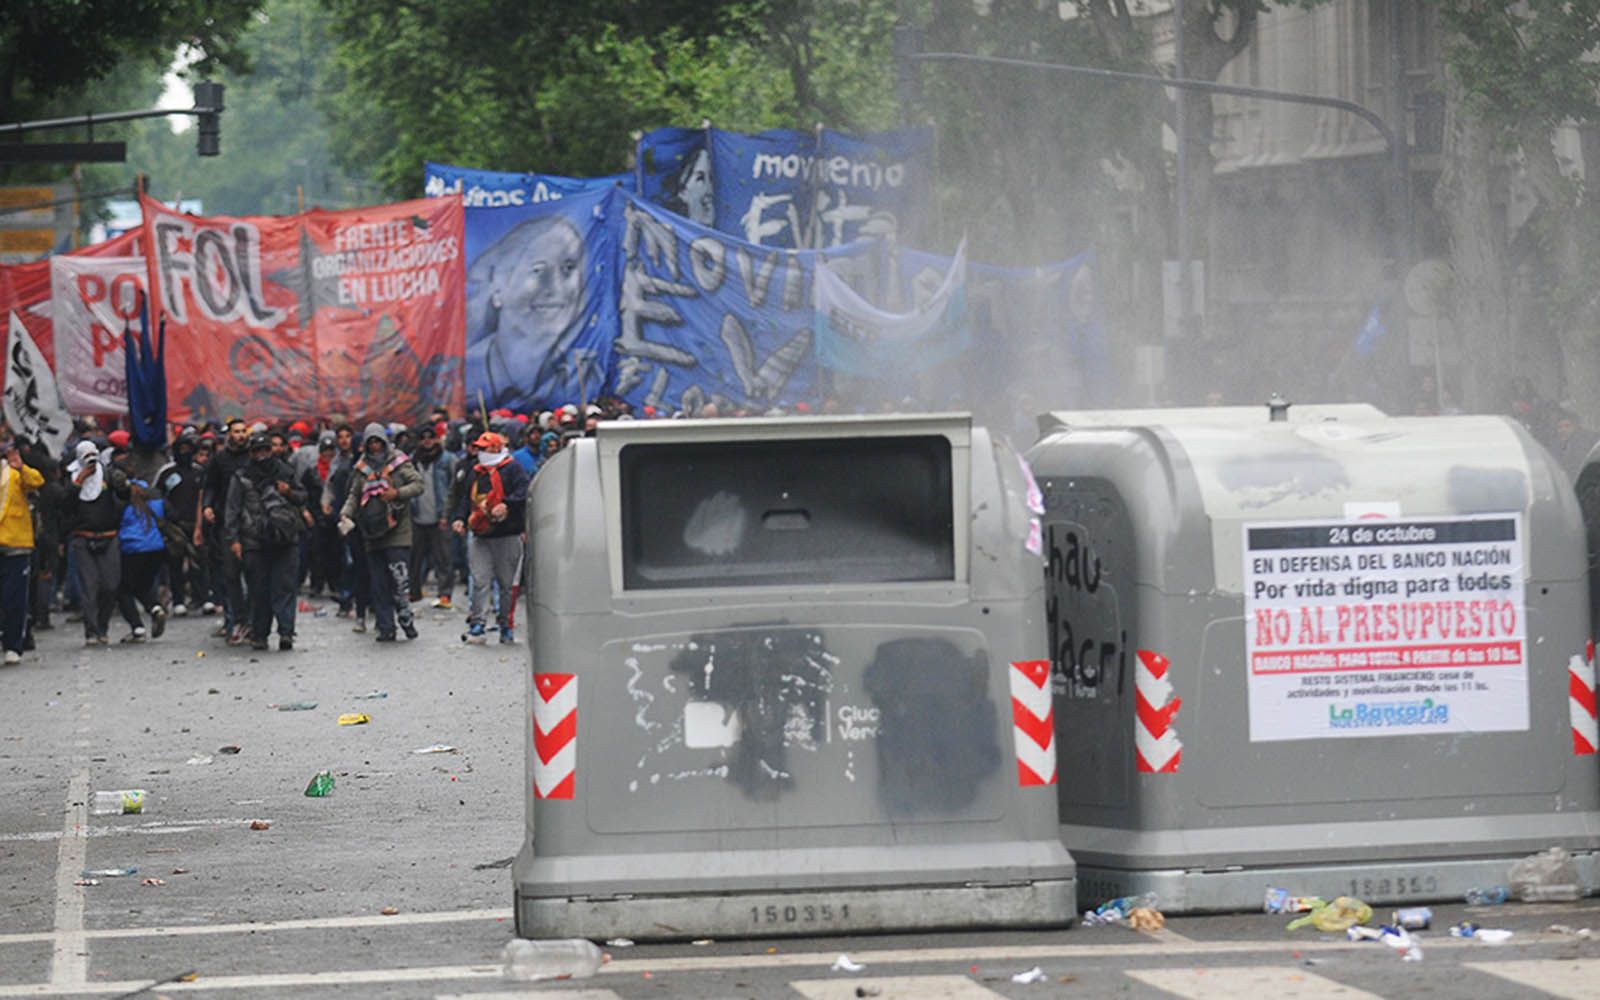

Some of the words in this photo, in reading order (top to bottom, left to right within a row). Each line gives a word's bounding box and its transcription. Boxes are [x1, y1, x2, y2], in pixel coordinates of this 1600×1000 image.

[335, 219, 409, 252] FRENTE
[153, 214, 287, 330] FOL
[312, 236, 459, 280] ORGANIZACIONES
[337, 276, 367, 304] EN
[371, 268, 441, 304] LUCHA
[1328, 527, 1350, 544] 24
[1351, 526, 1373, 543] de
[1375, 525, 1436, 542] octubre
[1044, 524, 1101, 594] hau
[1252, 557, 1274, 574] EN
[1279, 554, 1353, 574] DEFENSA
[1357, 553, 1388, 571] DEL
[1392, 550, 1447, 569] BANCO
[1451, 545, 1511, 567] NACIÓN
[1254, 580, 1287, 600] Por
[1294, 577, 1337, 598] vida
[1343, 575, 1399, 601] digna
[1405, 576, 1450, 599] para
[1456, 571, 1512, 593] todos
[1254, 606, 1292, 647] NO
[1298, 604, 1331, 645] AL
[1335, 598, 1517, 645] PRESUPUESTO
[1301, 674, 1332, 686] RESTO
[1334, 672, 1376, 684] SISTEMA
[1462, 670, 1474, 680] de
[1328, 703, 1354, 721] La
[1355, 697, 1449, 723] Bancaria
[750, 903, 850, 923] 150351
